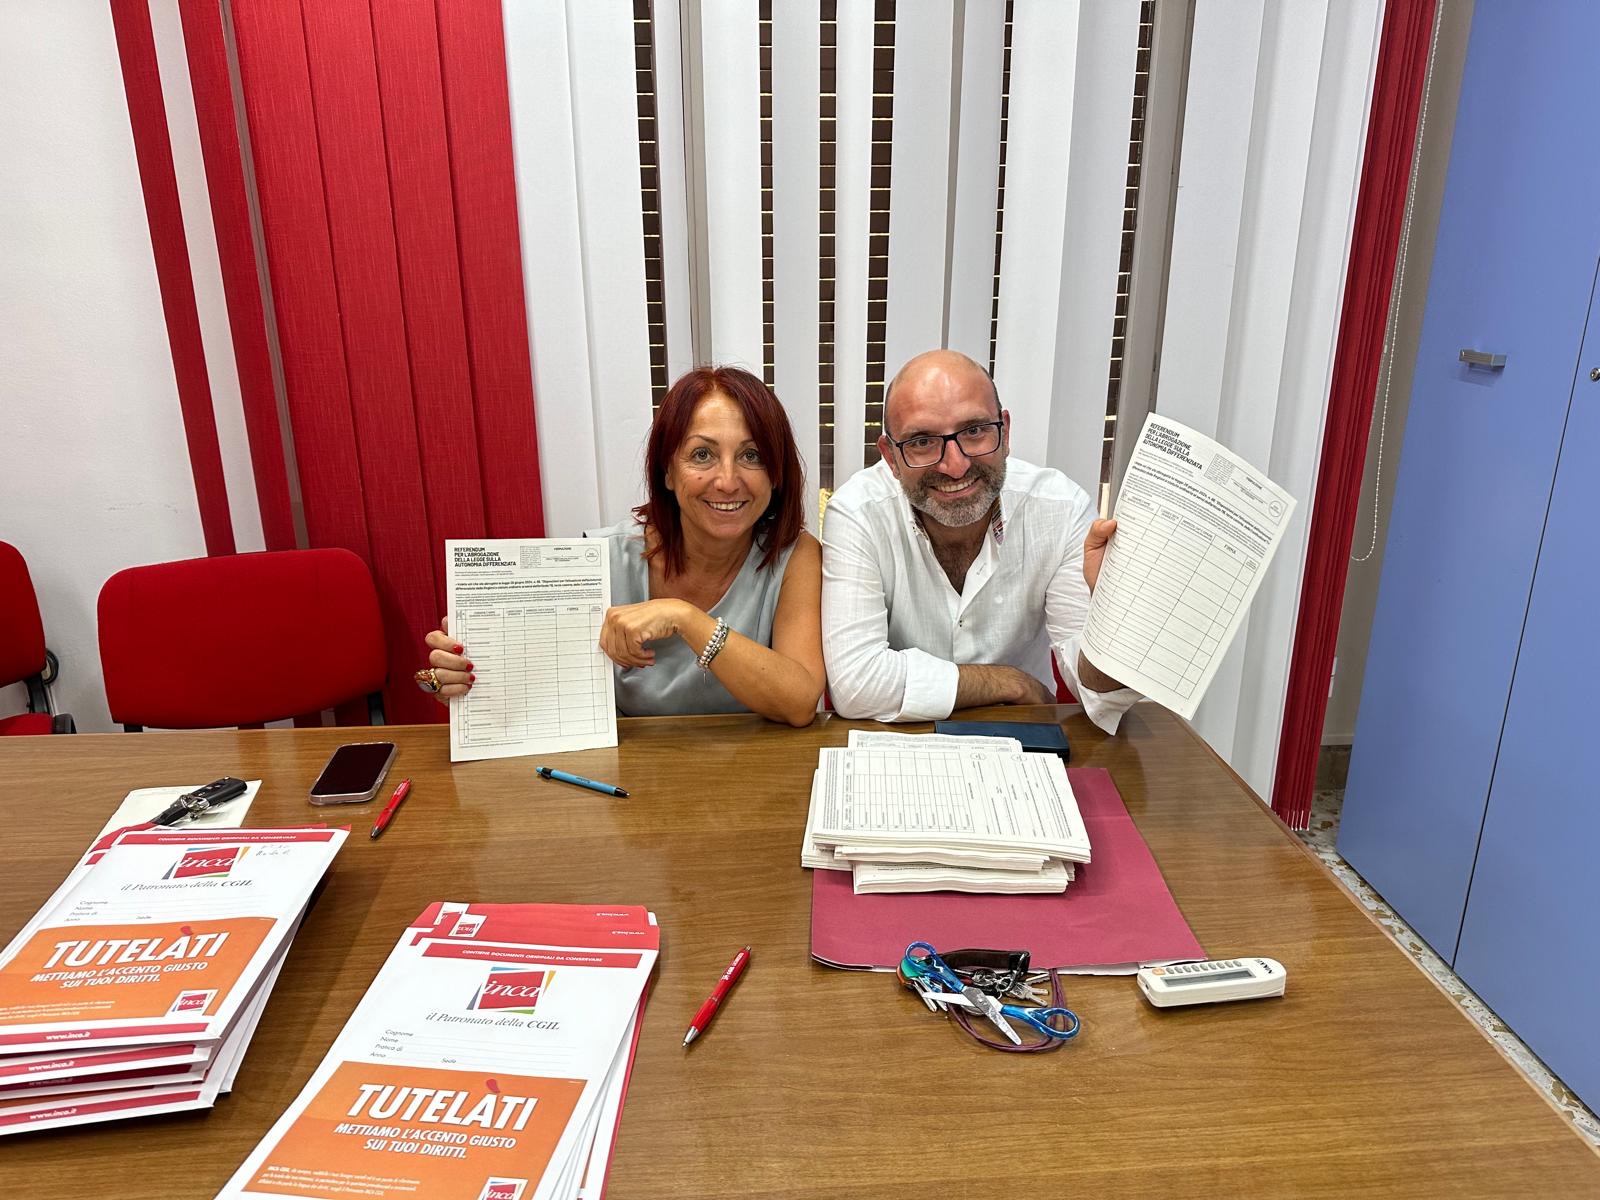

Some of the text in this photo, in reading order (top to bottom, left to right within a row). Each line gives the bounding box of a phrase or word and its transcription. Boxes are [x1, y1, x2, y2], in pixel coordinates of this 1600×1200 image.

[1150, 422, 1180, 438] REFERENDUM
[179, 857, 235, 868] inca
[30, 962, 209, 983] METTIAMO L'ACCENTO GIUSTO
[60, 974, 161, 989] SUI TUOI DIRITTI.
[482, 980, 540, 998] inca
[425, 1012, 561, 1030] il Patronato della CGIL
[46, 1031, 91, 1040] www.inca.it
[385, 1029, 414, 1037] Cognome
[28, 1060, 75, 1071] www.inca.it
[30, 1107, 77, 1120] www.inca.it
[334, 1123, 517, 1149] METTIAMO L'ACCENTO GIUSTO
[363, 1138, 467, 1159] SUI TUOI DIRITTI.
